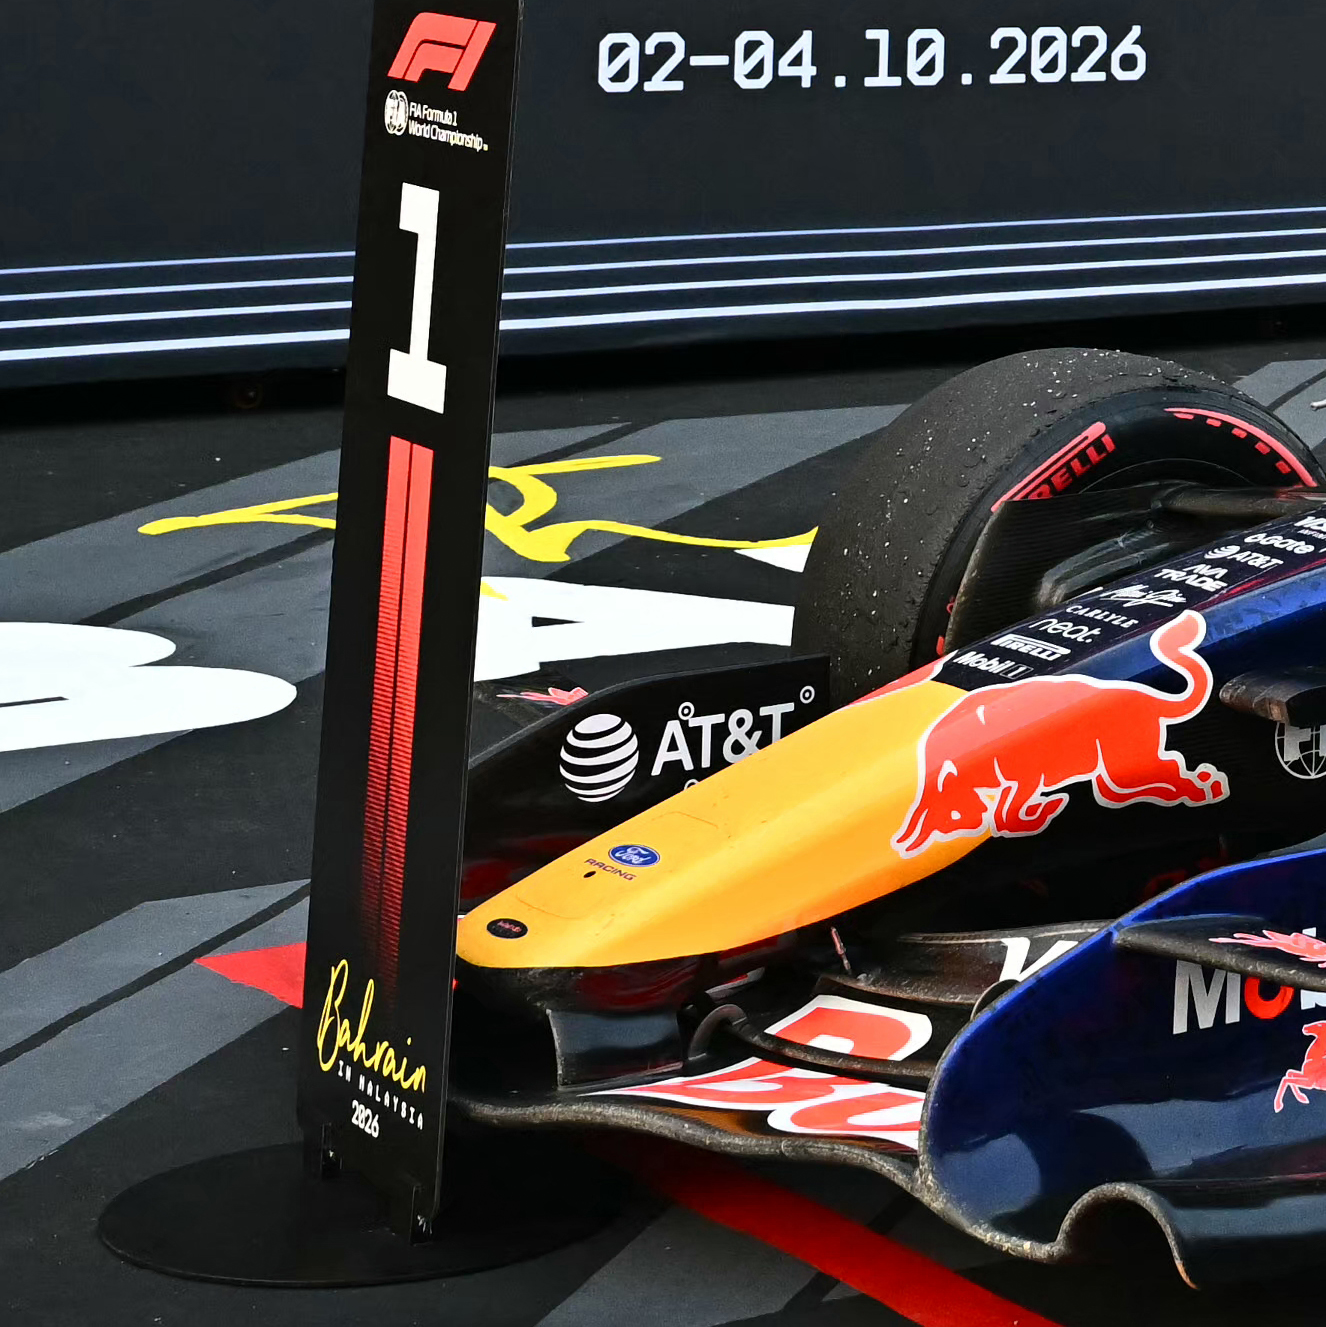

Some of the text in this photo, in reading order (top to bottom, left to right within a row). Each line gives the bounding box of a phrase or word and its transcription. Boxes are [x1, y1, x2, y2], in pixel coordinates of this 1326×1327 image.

[410, 102, 421, 118] FIA
[422, 105, 453, 126] Formula
[409, 119, 431, 138] World
[387, 182, 447, 414] 1
[1259, 538, 1316, 554] Gate
[1183, 564, 1229, 578] AVA
[1230, 549, 1284, 570] AT&T
[1153, 568, 1229, 593] TRADE
[1065, 605, 1139, 629] CARLYLE
[990, 633, 1072, 662] PIRELLI
[953, 651, 1010, 675] Mobil
[651, 702, 795, 776] AT&T
[612, 847, 652, 864] Ford
[584, 858, 637, 882] RACING
[317, 959, 427, 1093] Bahrain
[337, 1060, 424, 1130] IN MALAYSIA
[352, 1099, 380, 1139] 2026
